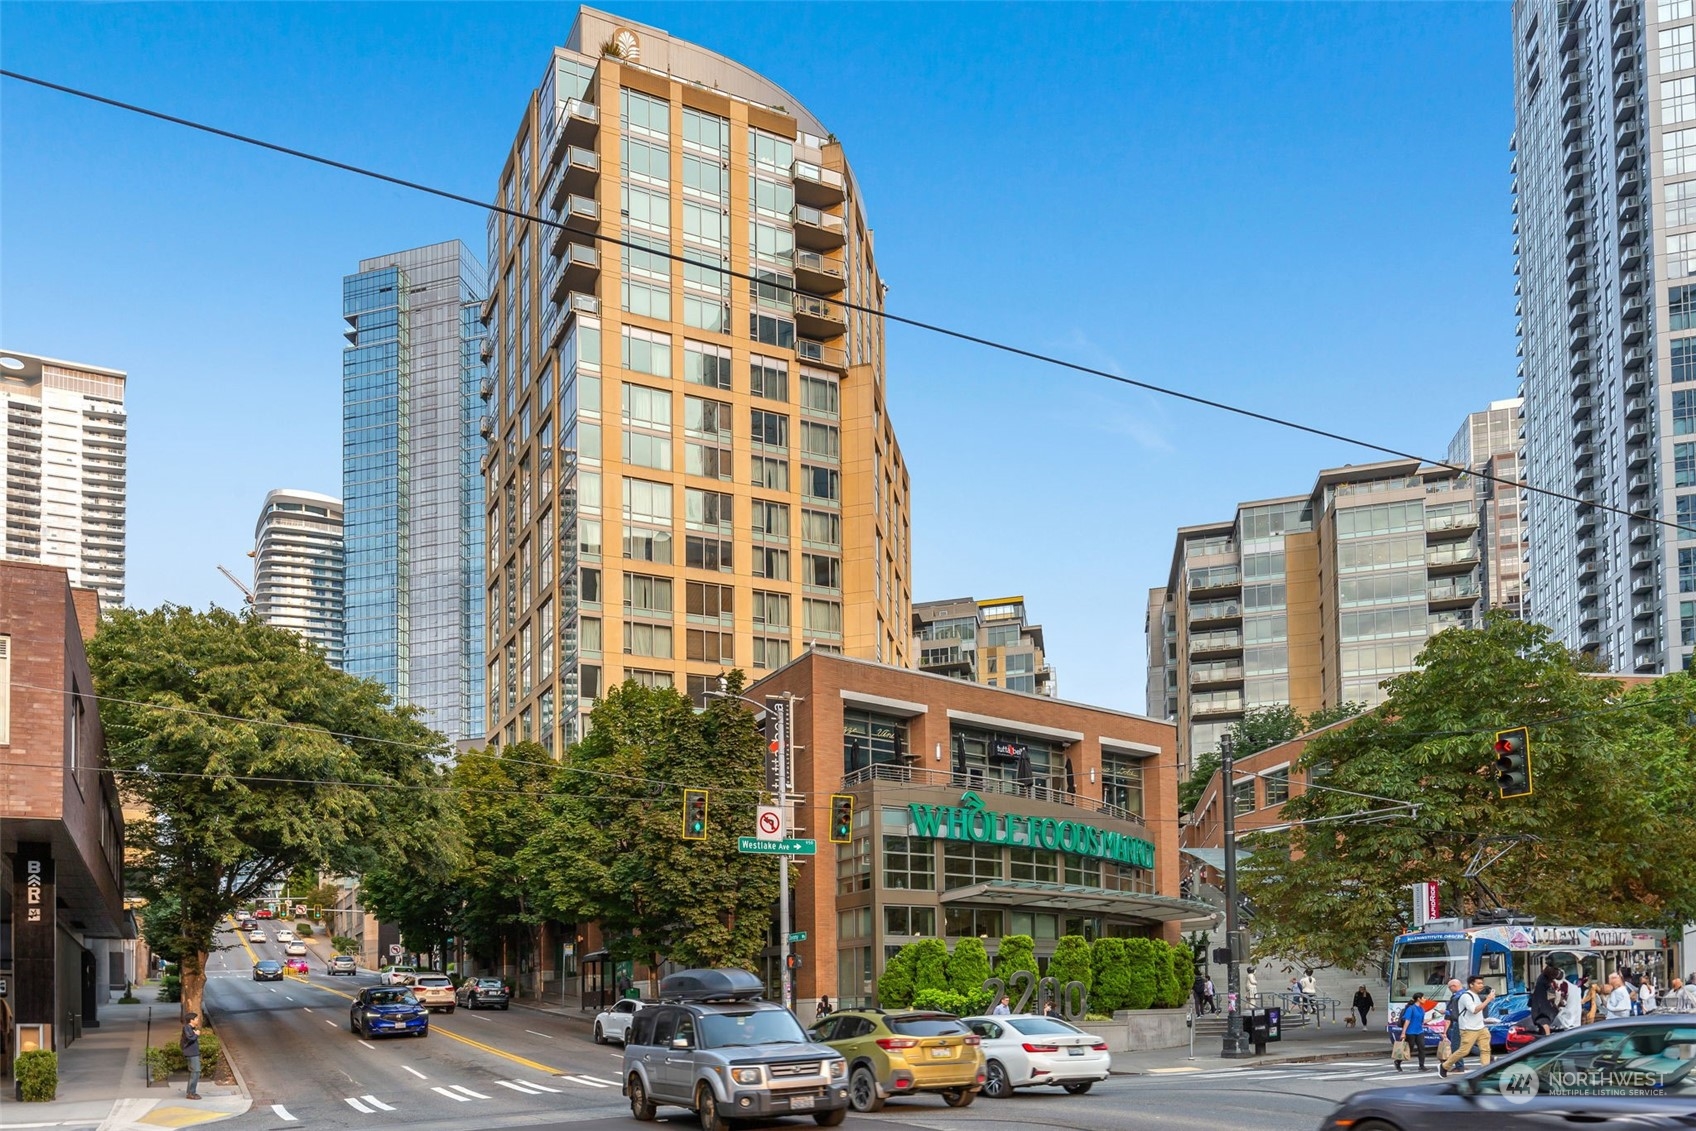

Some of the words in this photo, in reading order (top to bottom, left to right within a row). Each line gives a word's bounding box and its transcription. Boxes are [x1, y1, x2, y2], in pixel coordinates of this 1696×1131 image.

[742, 840, 777, 850] Westlake
[907, 803, 1024, 846] WHOLE
[1026, 816, 1100, 857] FOODS
[1098, 829, 1156, 870] MARKET
